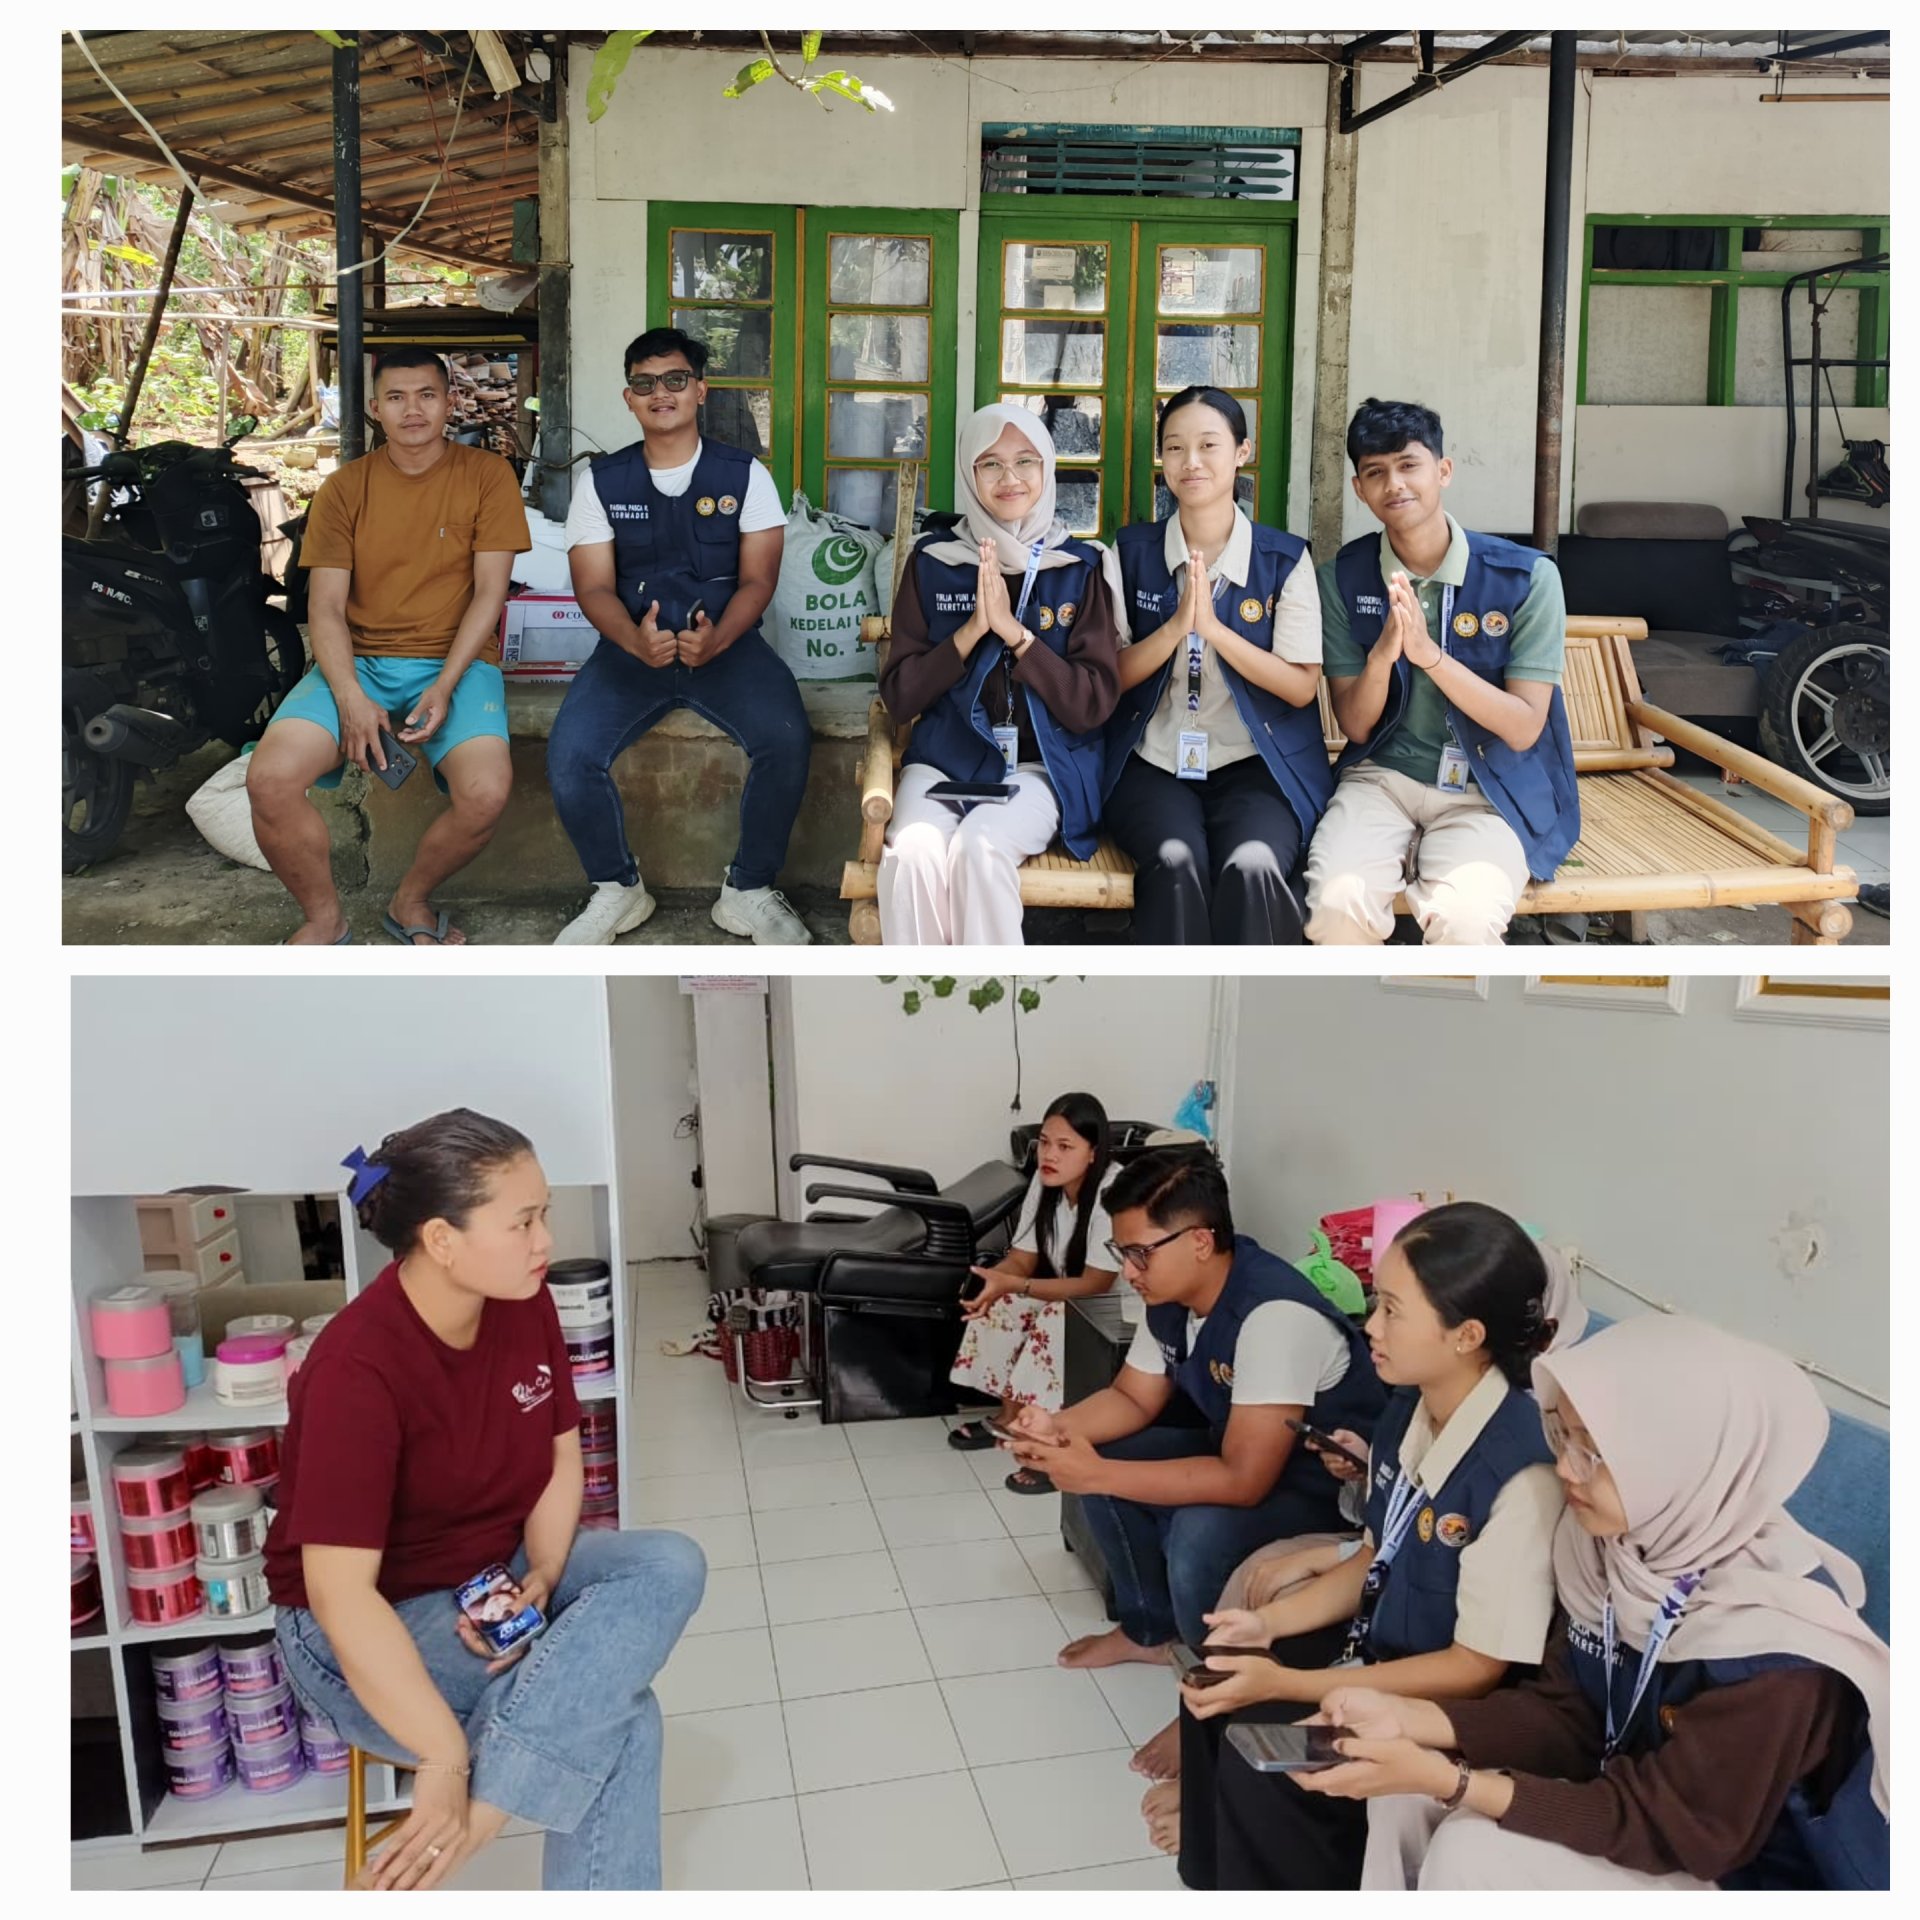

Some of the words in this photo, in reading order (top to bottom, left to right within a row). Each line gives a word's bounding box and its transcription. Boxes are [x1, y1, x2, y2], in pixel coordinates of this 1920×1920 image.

[806, 590, 867, 611] BOLA
[1356, 605, 1382, 615] LINGKU
[790, 616, 851, 631] KEDELAI
[807, 639, 845, 657] No.
[855, 634, 867, 653] 1
